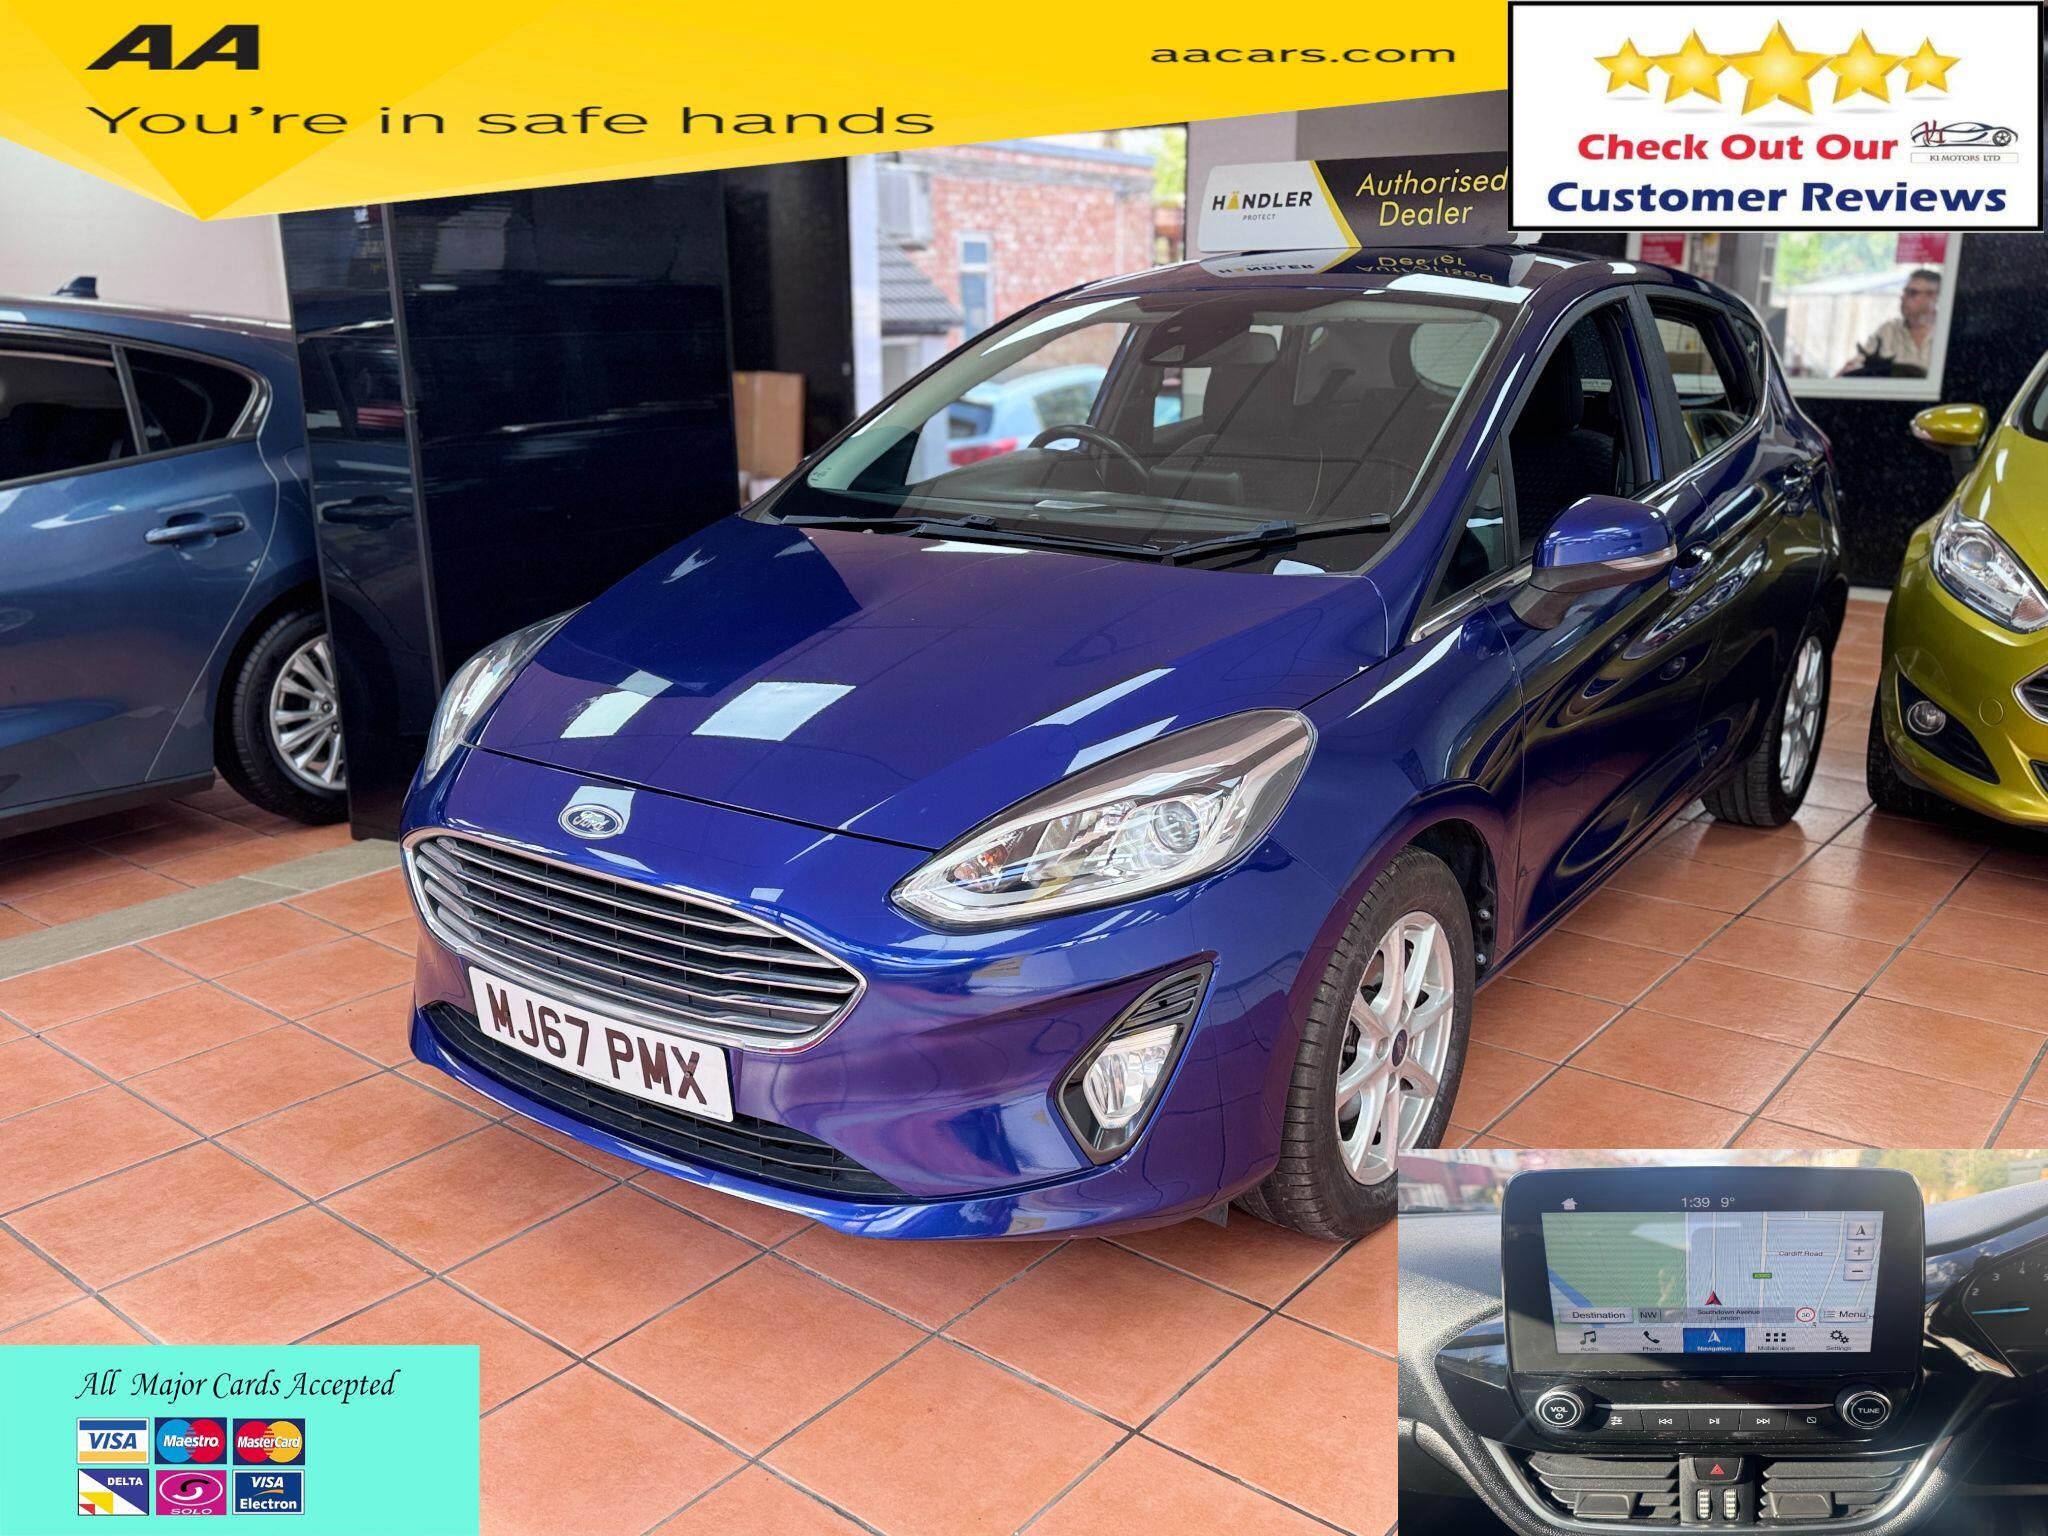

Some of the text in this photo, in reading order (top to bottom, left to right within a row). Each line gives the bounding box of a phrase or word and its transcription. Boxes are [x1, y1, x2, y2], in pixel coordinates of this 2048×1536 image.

[1355, 164, 1509, 197] Authorised
[1212, 190, 1313, 211] HÄNDLER
[1243, 213, 1276, 221] PROTECT
[1379, 198, 1474, 227] Dealer
[485, 982, 708, 1105] MJ67 PMX
[1680, 1197, 1710, 1208] 1:39
[1572, 1311, 1657, 1319] Destination NW
[1839, 1311, 1866, 1319] Menu
